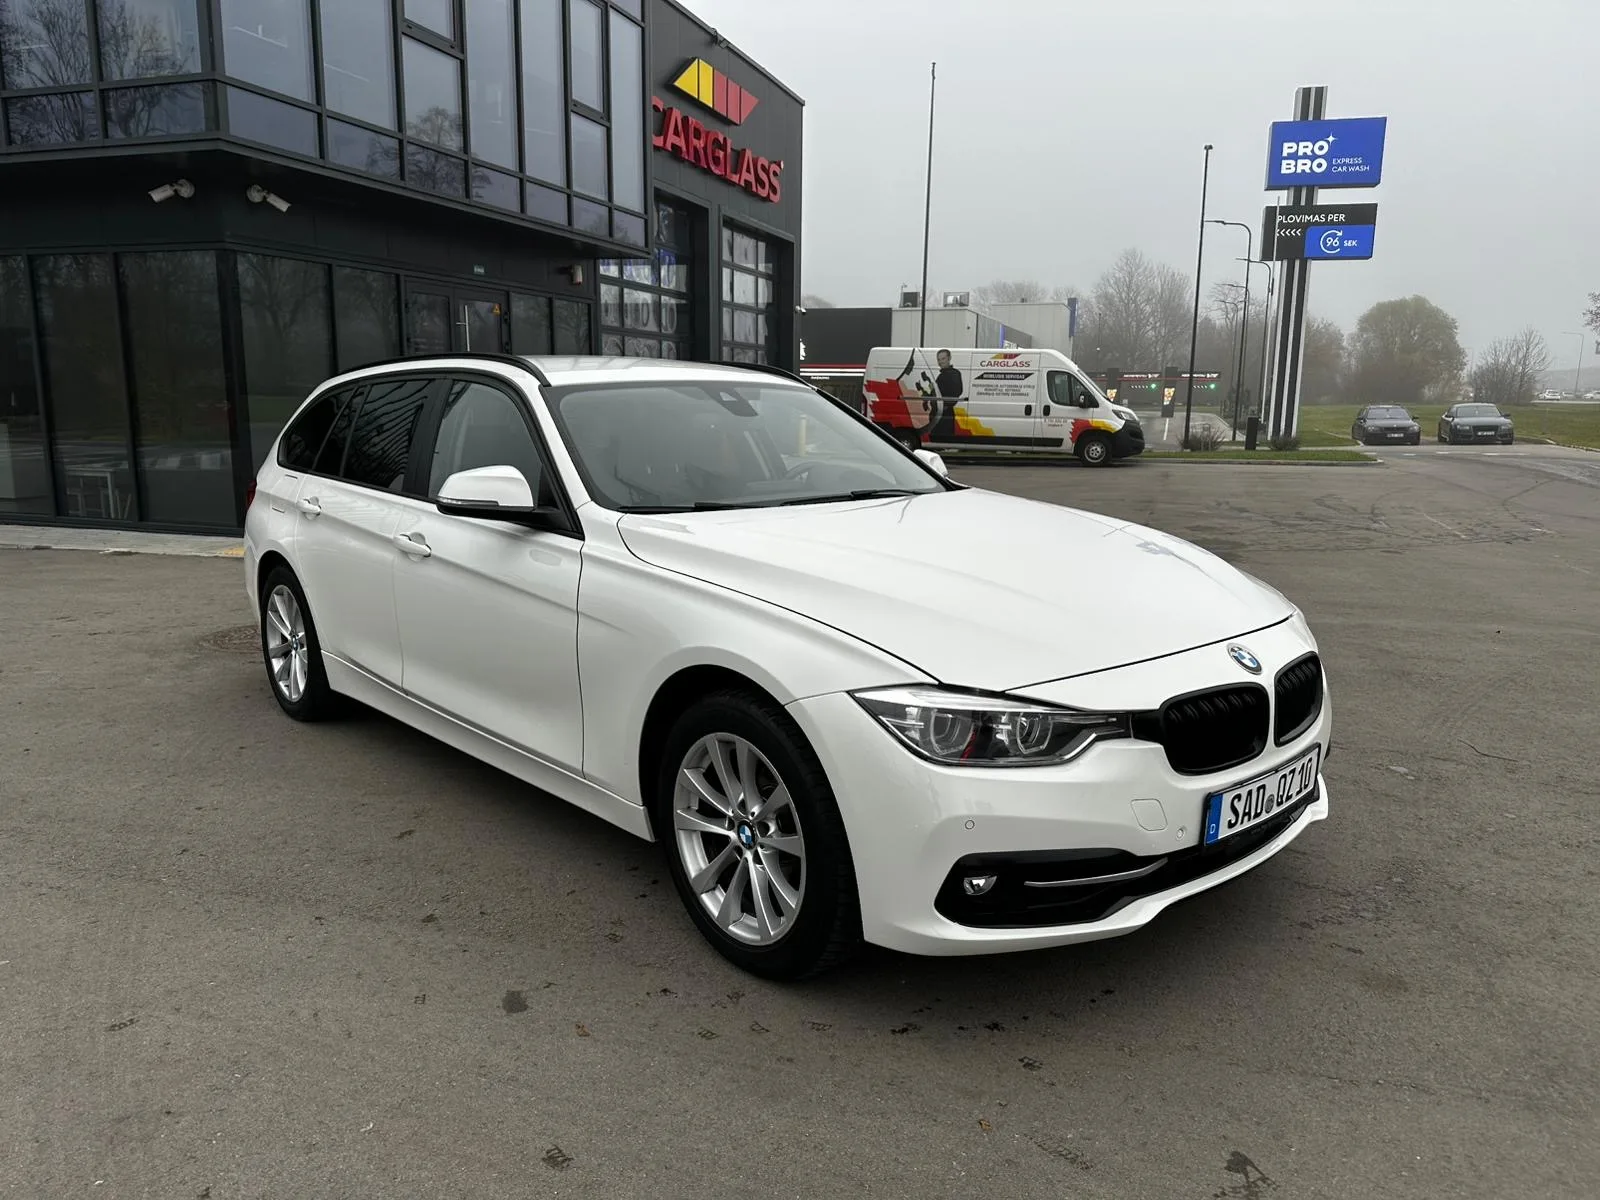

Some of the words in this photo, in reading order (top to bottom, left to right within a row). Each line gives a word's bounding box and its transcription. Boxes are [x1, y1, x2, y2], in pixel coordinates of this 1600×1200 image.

[1282, 141, 1329, 157] PRO
[1280, 158, 1327, 174] BRO
[1332, 157, 1362, 165] EXPRESS
[1332, 165, 1347, 173] CAR
[1277, 214, 1326, 223] PLOVIMAS
[1328, 213, 1346, 222] PER
[1326, 237, 1340, 247] 96
[980, 360, 1031, 368] CARGLASS
[1210, 823, 1216, 834] D
[1227, 784, 1266, 829] SAD
[1276, 767, 1297, 807] QZ
[1295, 757, 1313, 796] 10
